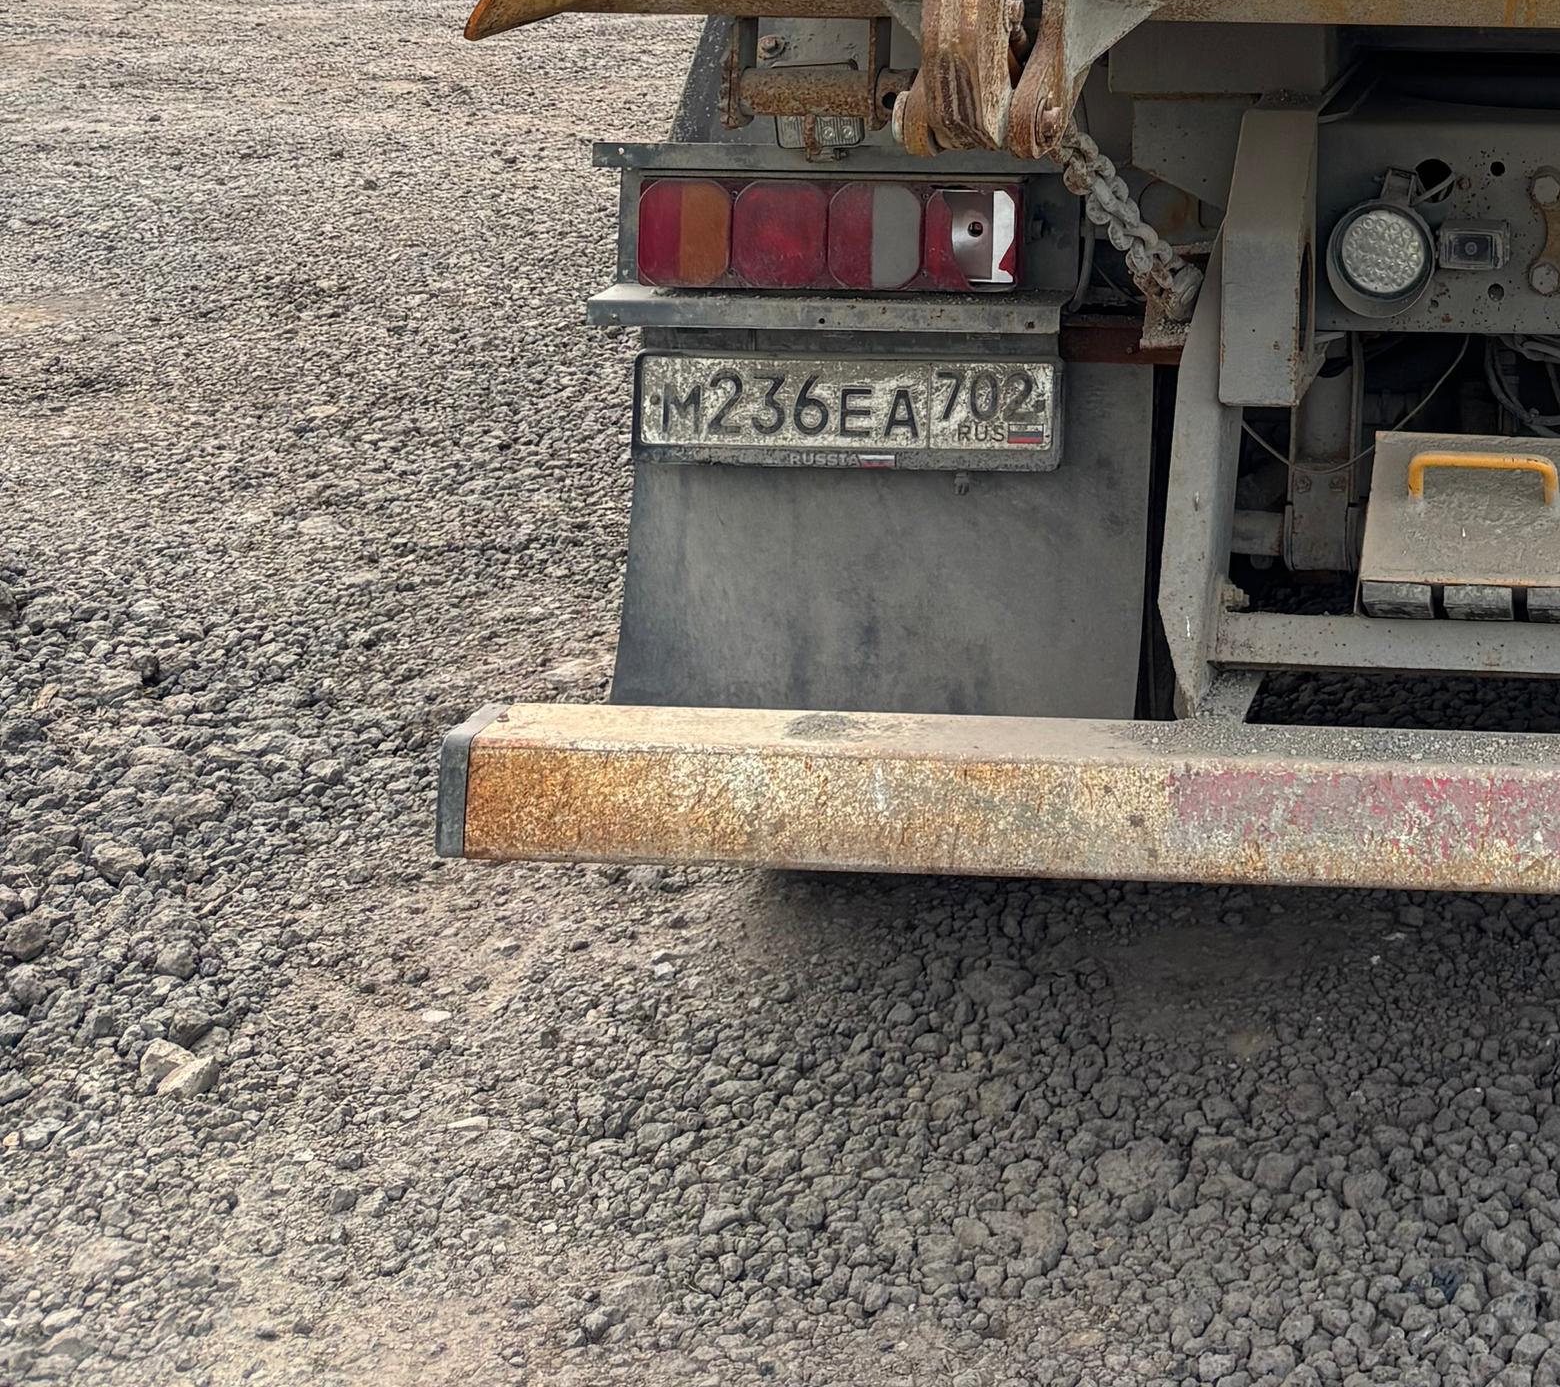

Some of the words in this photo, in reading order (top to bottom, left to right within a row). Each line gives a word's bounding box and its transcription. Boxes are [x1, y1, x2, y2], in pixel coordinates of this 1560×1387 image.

[661, 367, 919, 438] М236ЕА
[935, 371, 1040, 422] 702
[957, 423, 1005, 442] RUS
[789, 453, 861, 467] RUSSIA
